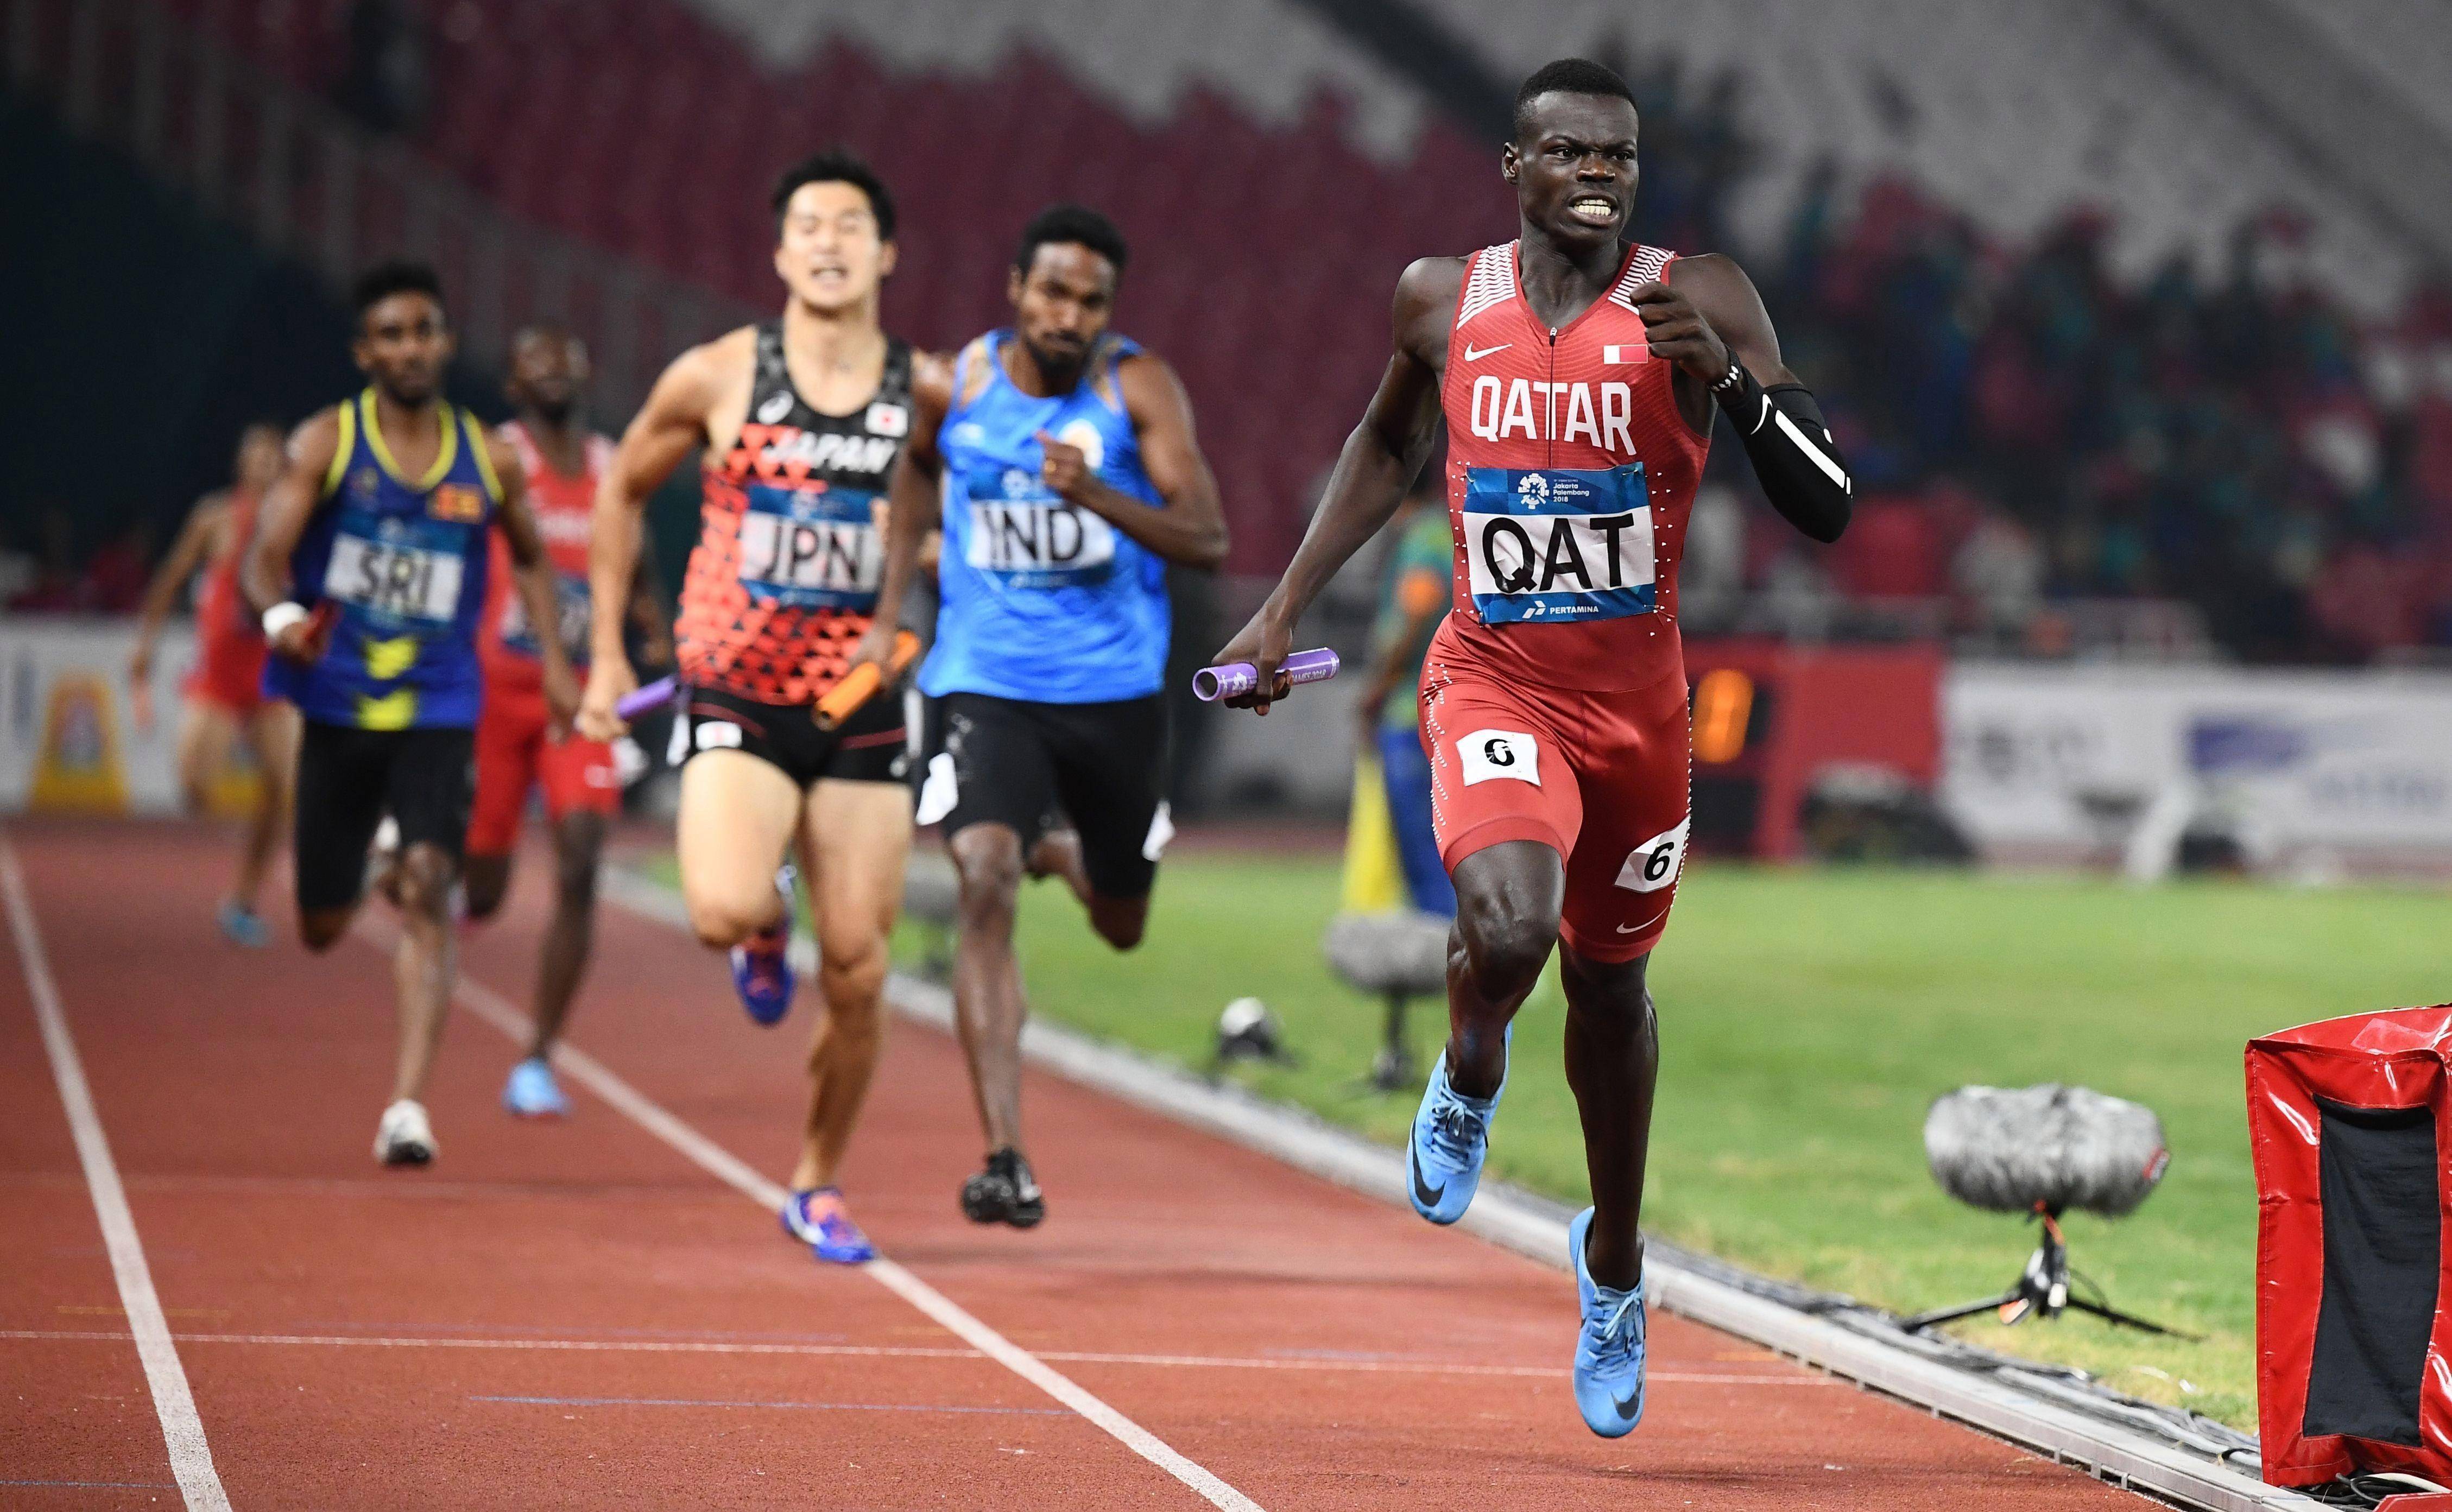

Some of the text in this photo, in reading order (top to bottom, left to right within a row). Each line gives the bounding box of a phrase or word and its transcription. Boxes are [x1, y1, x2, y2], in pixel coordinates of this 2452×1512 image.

[1471, 375, 1636, 456] QATAR
[761, 431, 897, 474] JAPAN
[356, 547, 433, 610] SRI
[759, 520, 863, 585] JPN
[1482, 513, 1634, 593] QAT
[1550, 606, 1599, 615] PERTAMINA
[1644, 841, 1674, 882] 6
